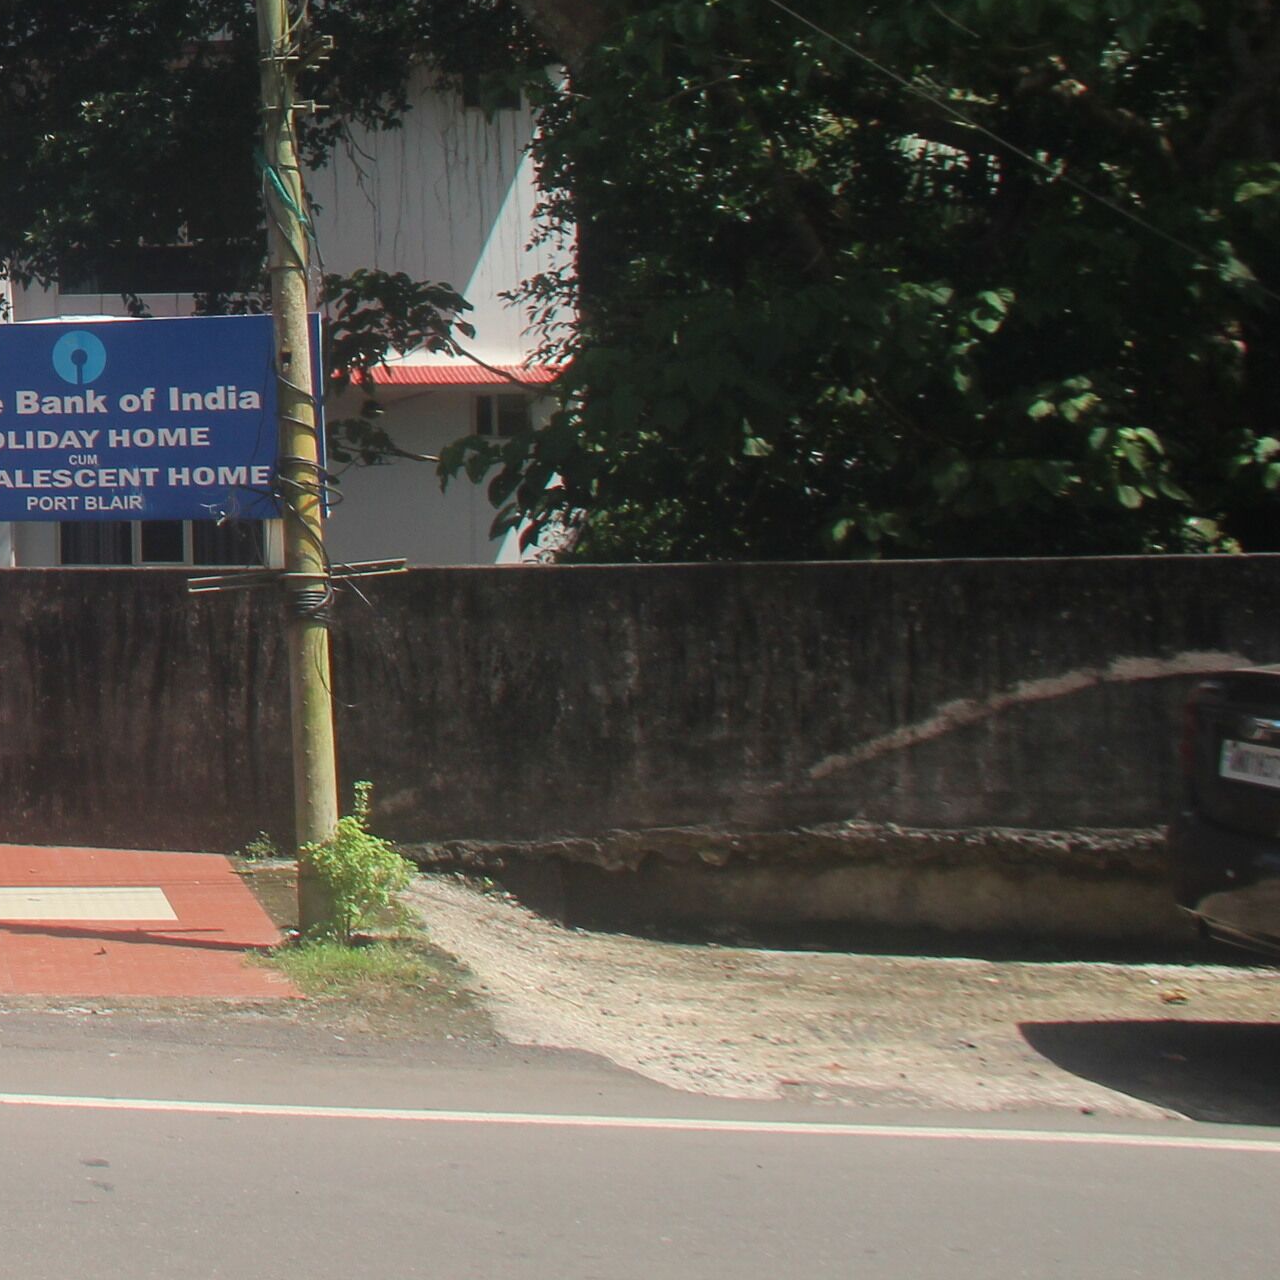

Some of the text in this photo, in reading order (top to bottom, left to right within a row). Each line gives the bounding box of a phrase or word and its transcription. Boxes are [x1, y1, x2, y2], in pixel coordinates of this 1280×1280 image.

[15, 389, 109, 414] Bank
[118, 387, 156, 413] of
[169, 385, 261, 412] India
[108, 427, 210, 448] HOME
[68, 454, 98, 466] CUM
[167, 466, 270, 487] HOME
[26, 495, 143, 511] PORT BLAIR
